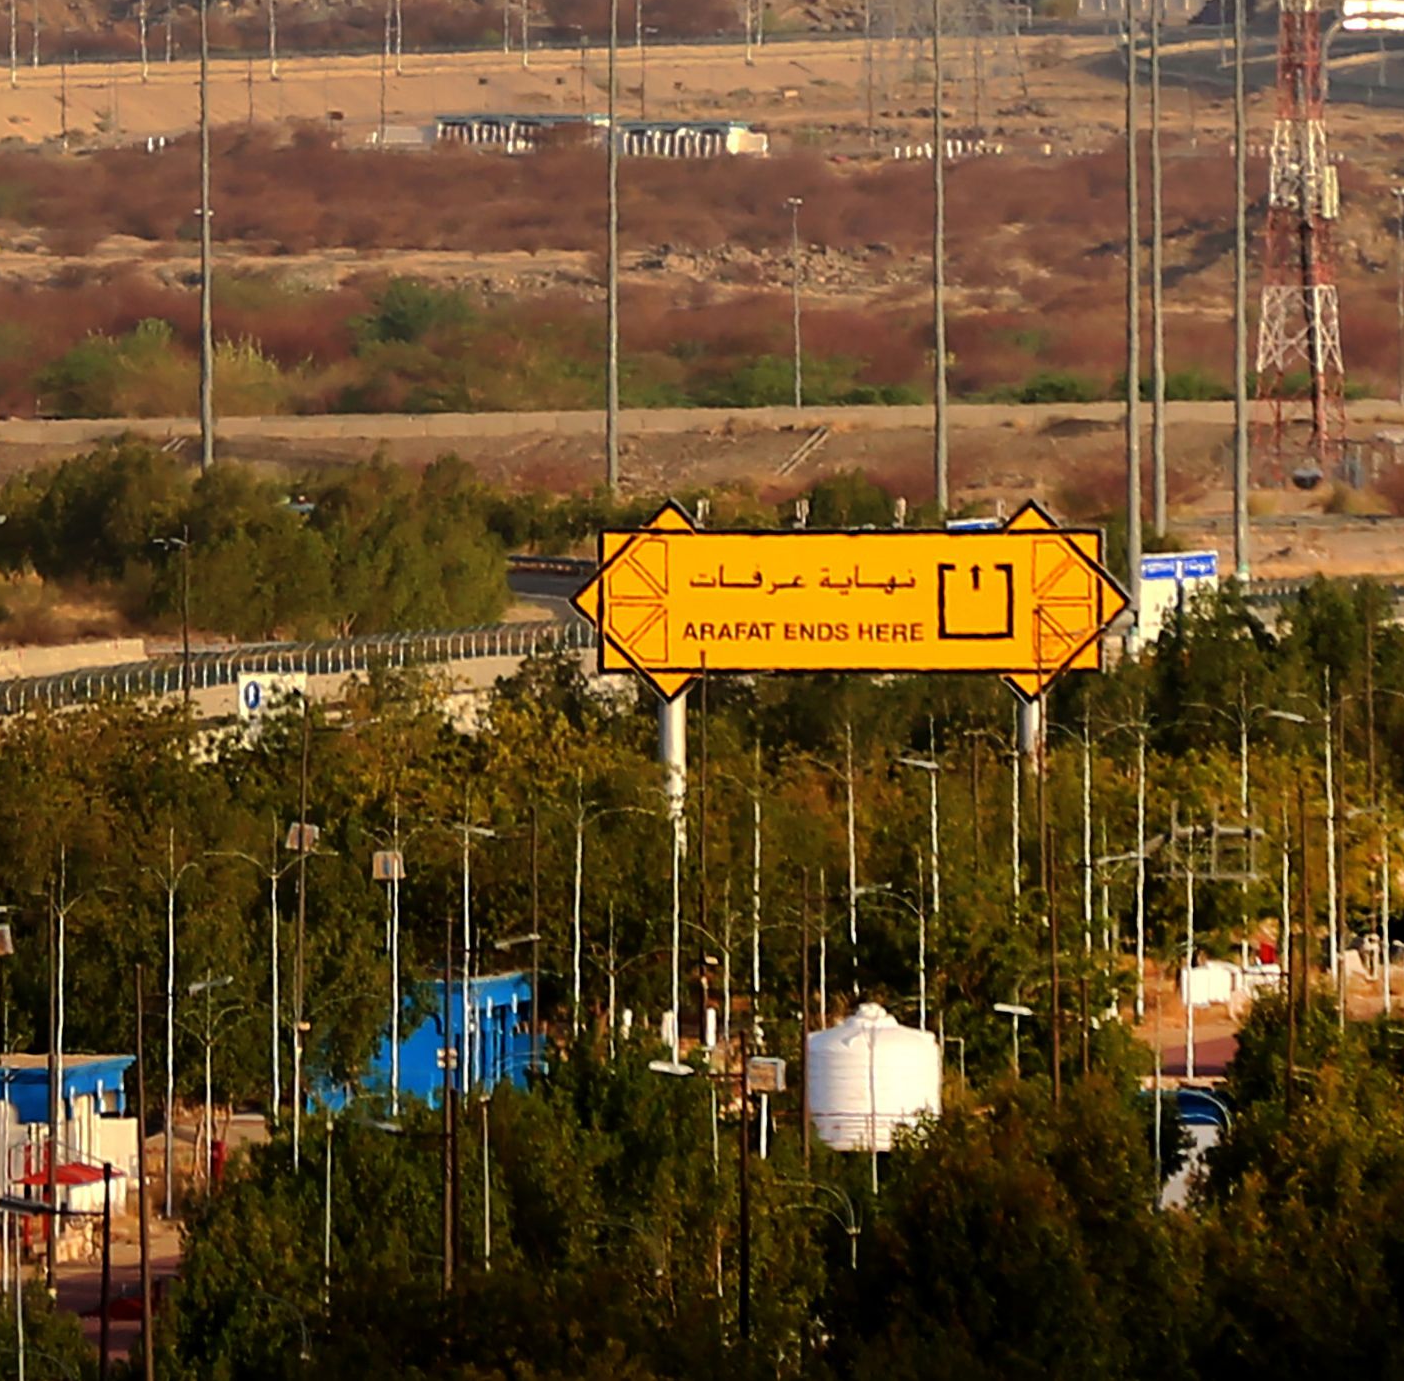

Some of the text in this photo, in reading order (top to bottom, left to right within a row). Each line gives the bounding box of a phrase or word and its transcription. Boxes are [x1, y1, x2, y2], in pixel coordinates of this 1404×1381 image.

[689, 564, 916, 595] نهاية عرفات
[682, 622, 924, 642] ARAFAT ENDS HERE
